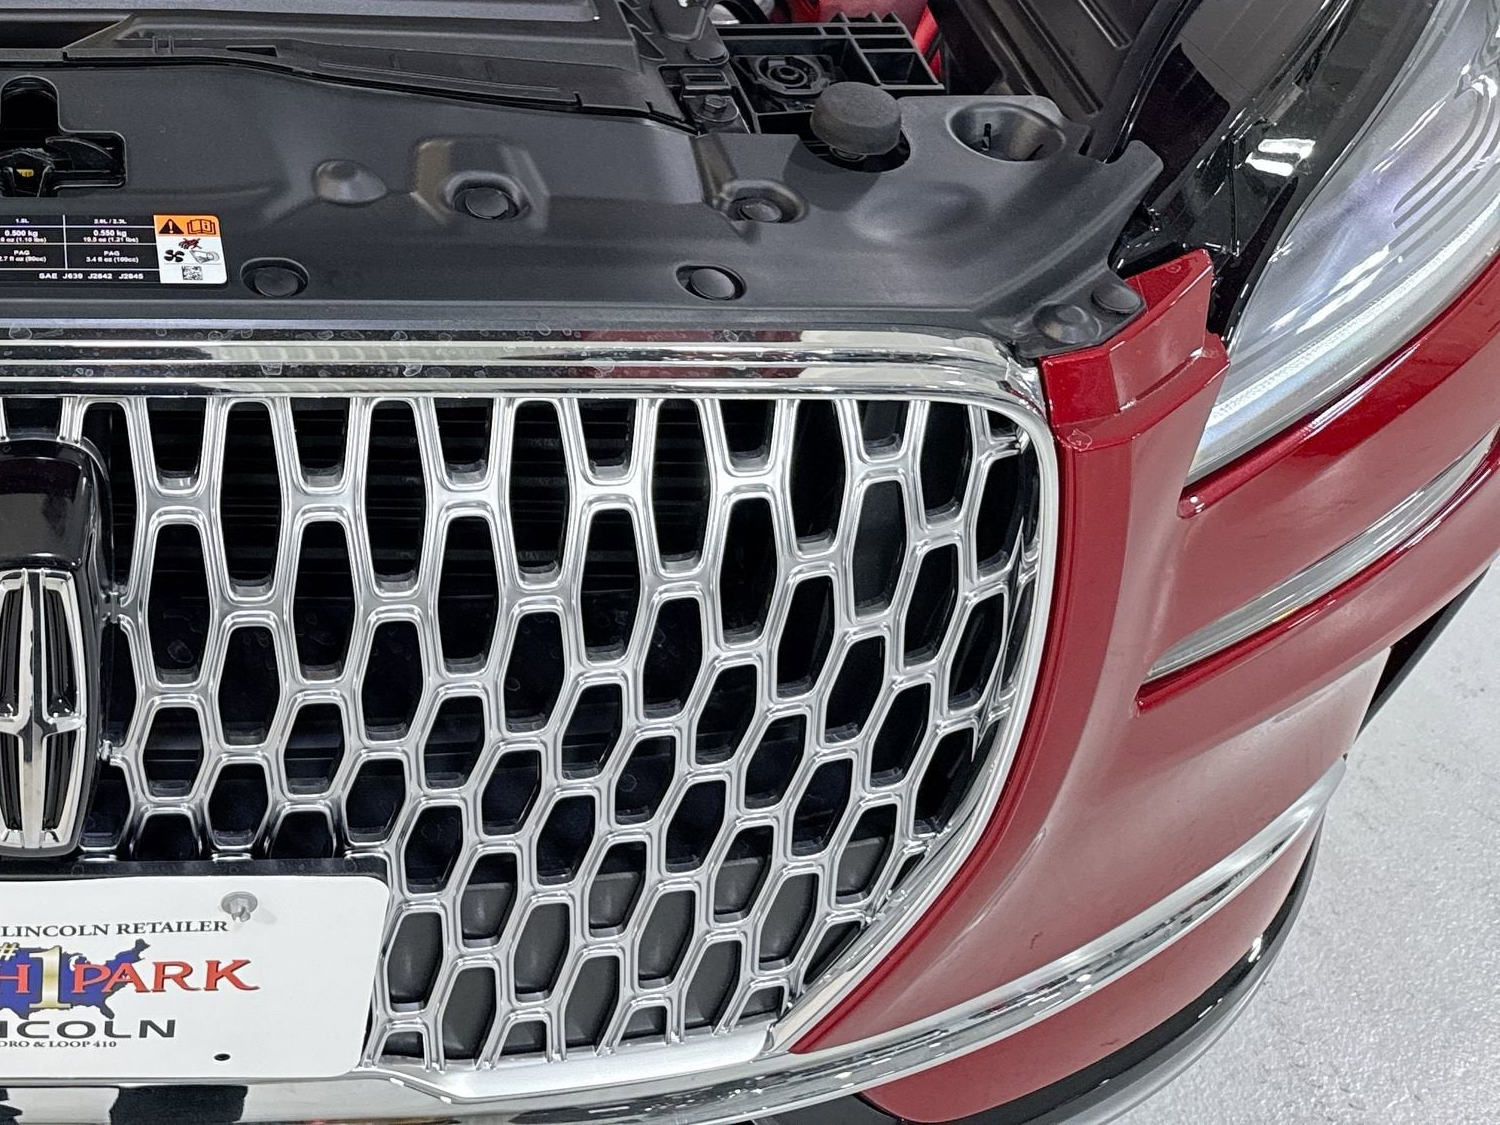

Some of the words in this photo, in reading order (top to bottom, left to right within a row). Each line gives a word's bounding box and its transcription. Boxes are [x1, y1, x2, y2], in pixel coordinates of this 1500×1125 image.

[27, 229, 39, 237] kg
[116, 229, 127, 238] kg
[0, 924, 111, 938] LINCOLN
[115, 920, 230, 936] RETAILER
[72, 959, 261, 993] PARK
[33, 1040, 47, 1048] &
[49, 1040, 91, 1049] LOOP
[93, 1040, 118, 1048] 410
